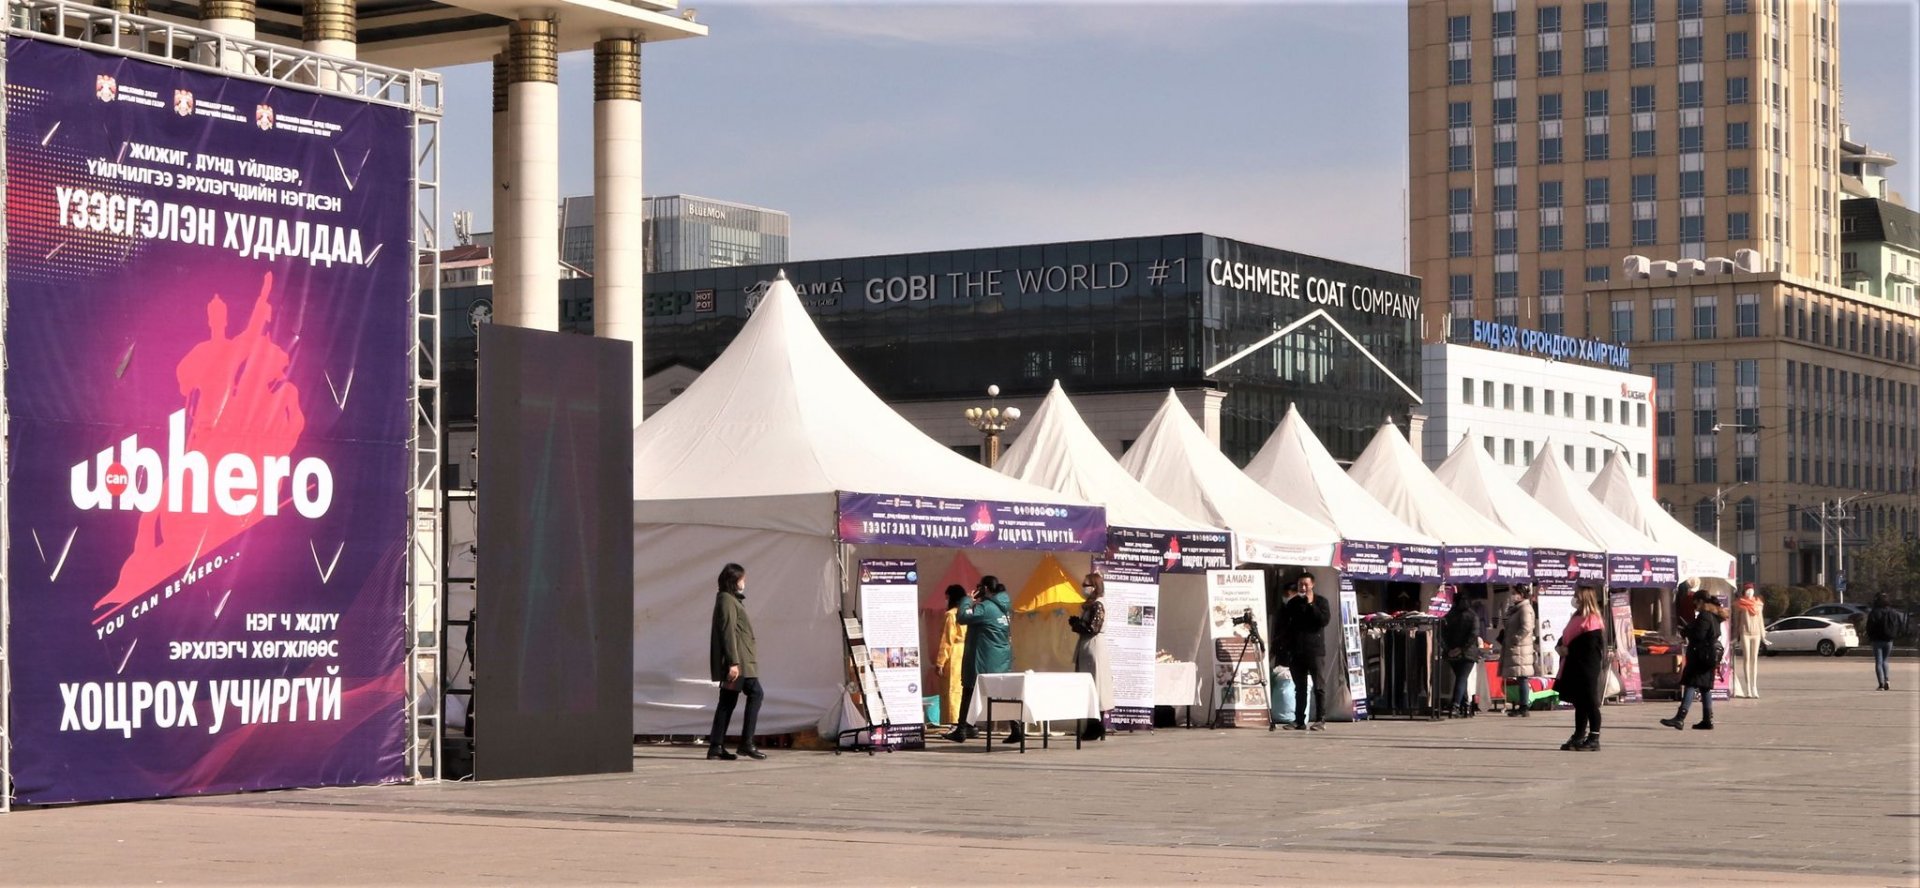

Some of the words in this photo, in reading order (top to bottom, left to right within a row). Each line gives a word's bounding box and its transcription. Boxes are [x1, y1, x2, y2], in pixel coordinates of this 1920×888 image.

[130, 142, 191, 169] ЖИЖИГ,
[195, 153, 234, 177] ДУНД
[238, 157, 303, 186] ҮЙЛДВЭР,
[87, 159, 173, 186] ҮЙЛЧИЛГЭЭ
[176, 172, 277, 204] ЭРХЛЭГЧДИЙН
[281, 190, 341, 212] НЭГДСЭН
[56, 187, 216, 246] ҮЗЭСГЭЛЭН
[222, 212, 363, 268] ХУДАЛДАА
[695, 292, 711, 301] HOT
[796, 277, 844, 295] AMÁ
[865, 274, 936, 304] GOBI
[946, 270, 1003, 298] THE
[1016, 261, 1130, 295] WORLD
[1147, 257, 1188, 286] #1
[1210, 257, 1300, 300] CASHMERE
[1306, 276, 1347, 308] COAT
[1351, 284, 1421, 321] COMPANY
[643, 290, 692, 317] EEP
[695, 300, 712, 309] POT
[1473, 320, 1500, 349] БИД
[1502, 325, 1518, 347] ЭХ
[1521, 328, 1577, 360] ОРОНДОО
[1579, 336, 1630, 368] ХАЙРТАЙ!
[106, 473, 128, 485] can
[998, 528, 1034, 544] ХОЦРОХ
[96, 615, 124, 641] YOU
[132, 593, 160, 619] CAN
[165, 580, 182, 600] BE
[246, 613, 277, 632] НЭГ
[281, 614, 291, 631] Ч
[295, 613, 340, 633] ЖДҮҮ
[169, 640, 247, 660] ЭРХЛЭГЧ
[251, 639, 339, 660] ХӨГЖЛӨӨС
[59, 680, 199, 739] ХОЦРОХ
[209, 665, 342, 734] УЧИРГҮЙ
